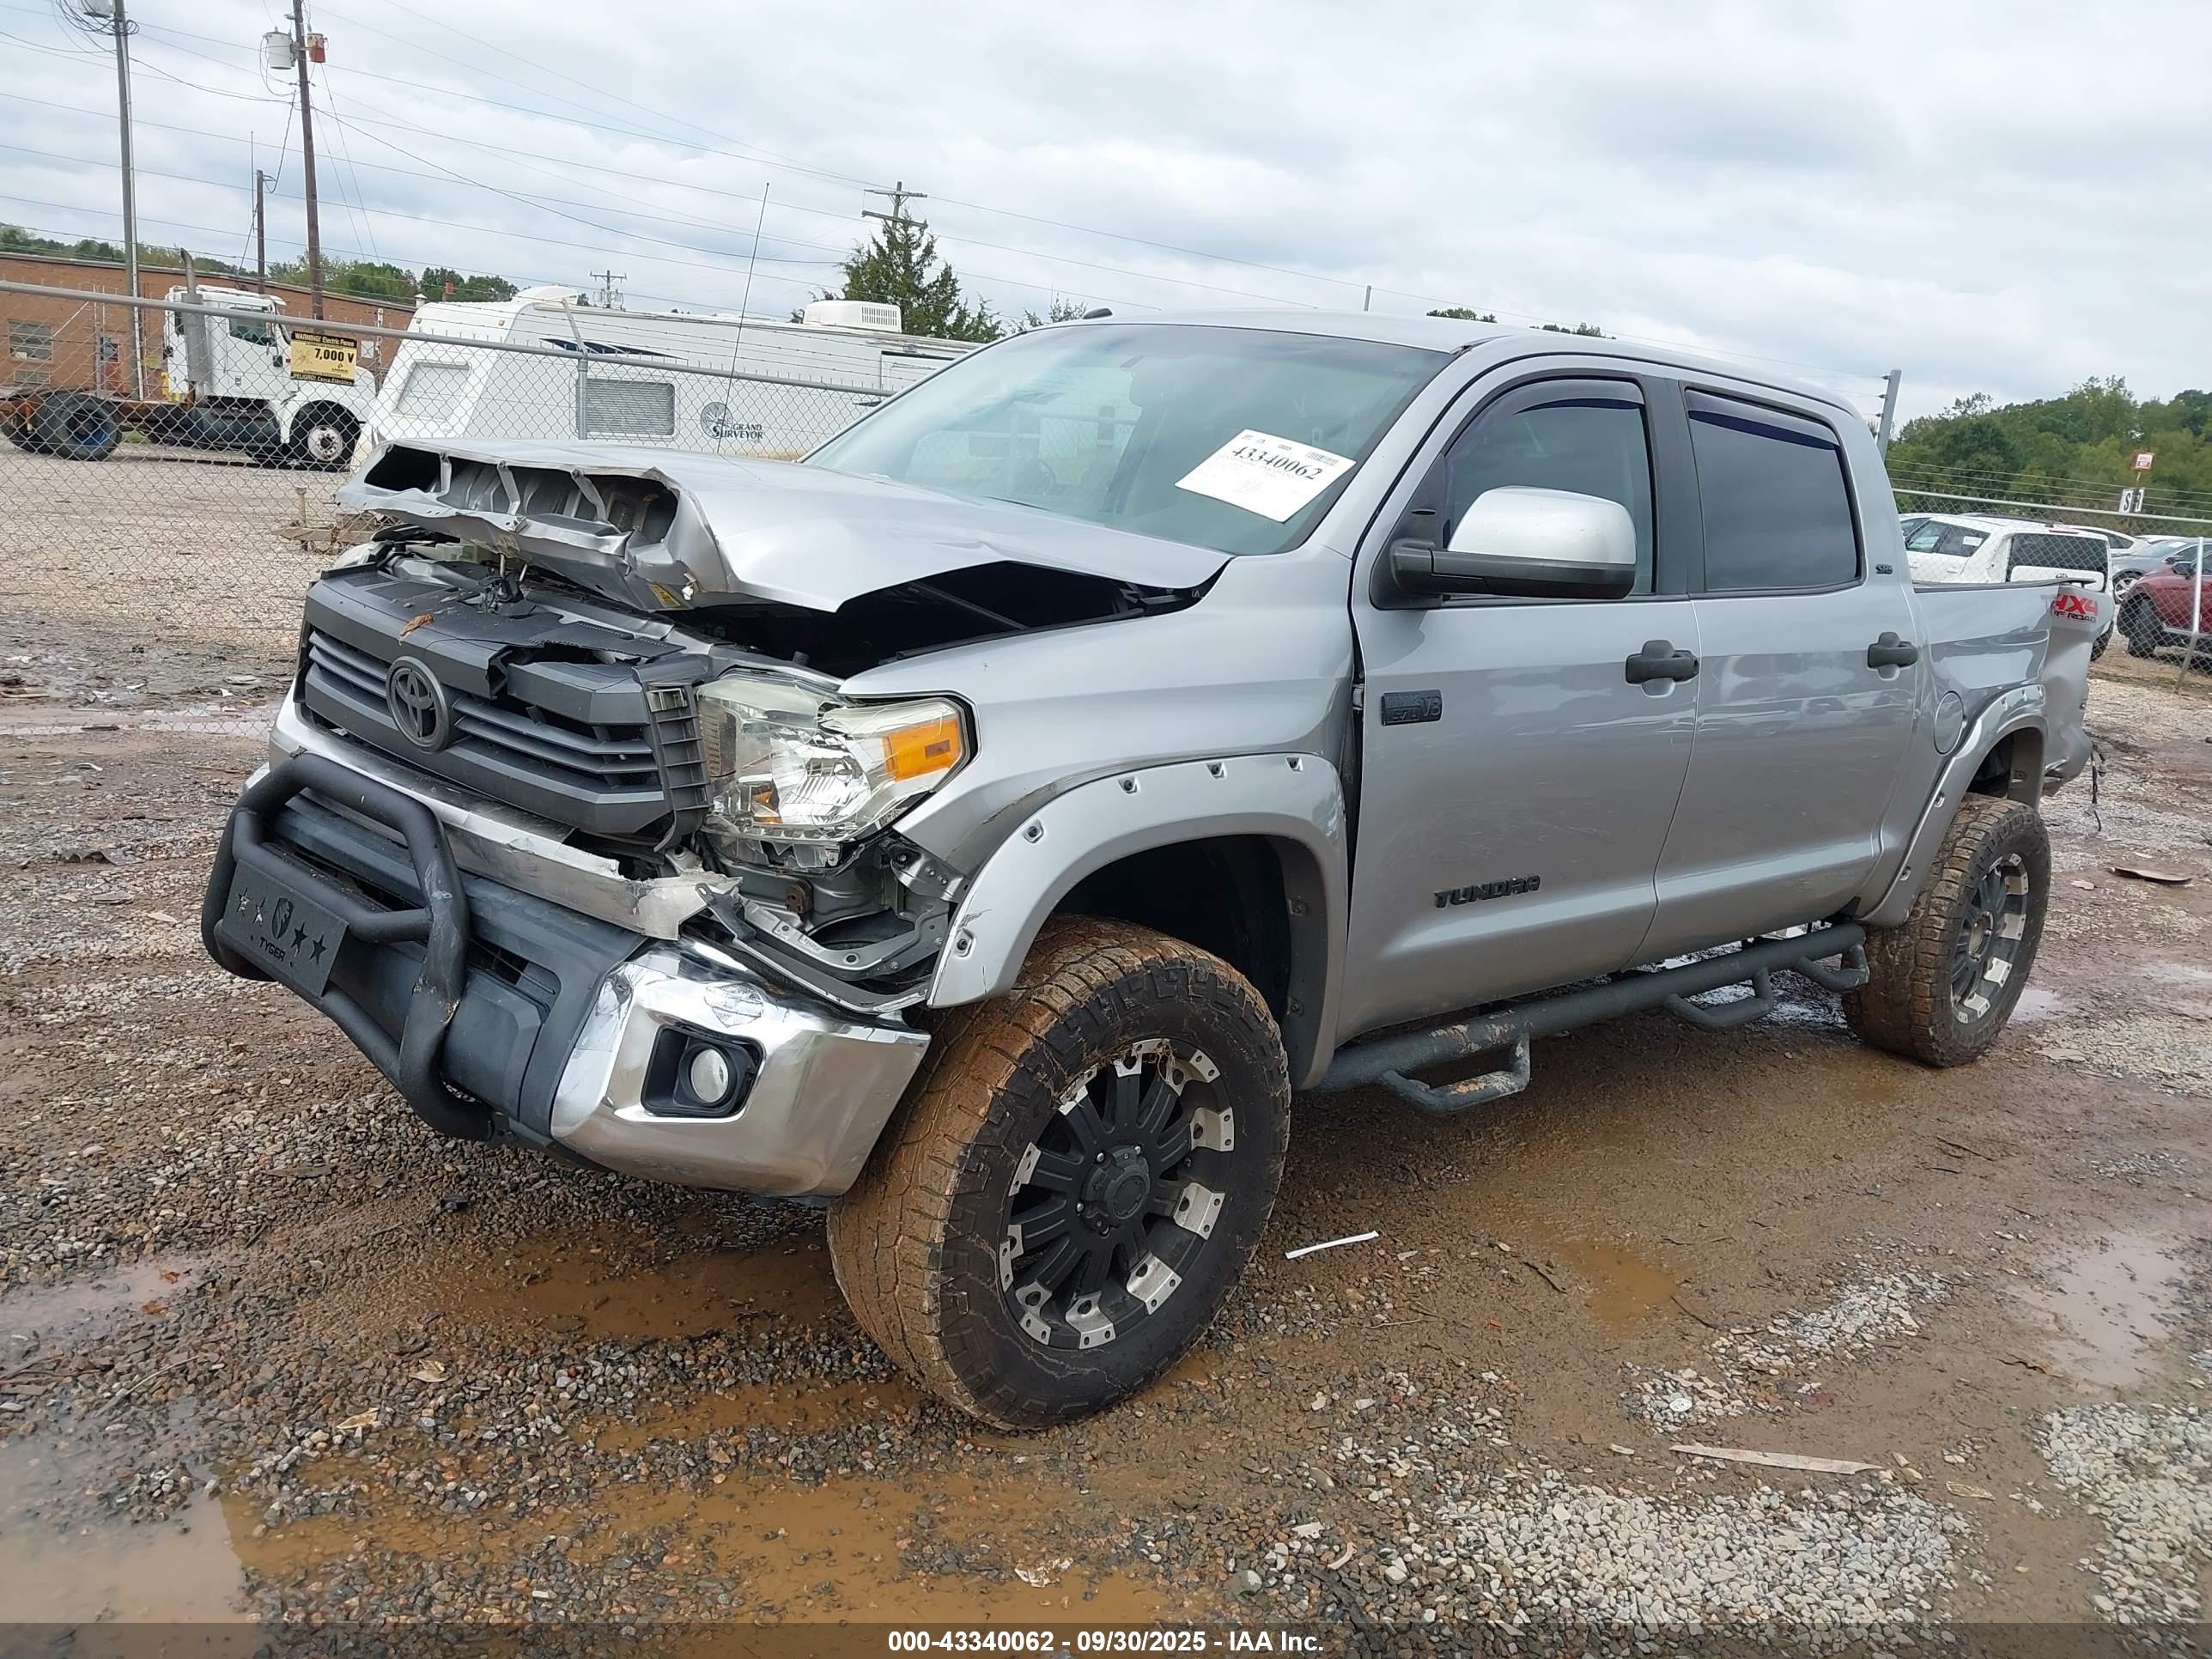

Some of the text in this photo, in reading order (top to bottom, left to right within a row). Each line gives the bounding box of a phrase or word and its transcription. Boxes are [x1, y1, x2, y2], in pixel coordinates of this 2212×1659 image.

[322, 336, 340, 345] Electric
[315, 348, 354, 363] 7,000 V
[713, 425, 763, 439] SURVEYOR
[1232, 445, 1323, 480] 43340062
[2067, 612, 2096, 623] ROAD
[1434, 875, 1540, 908] TUNDRA
[259, 937, 286, 962] TYGER
